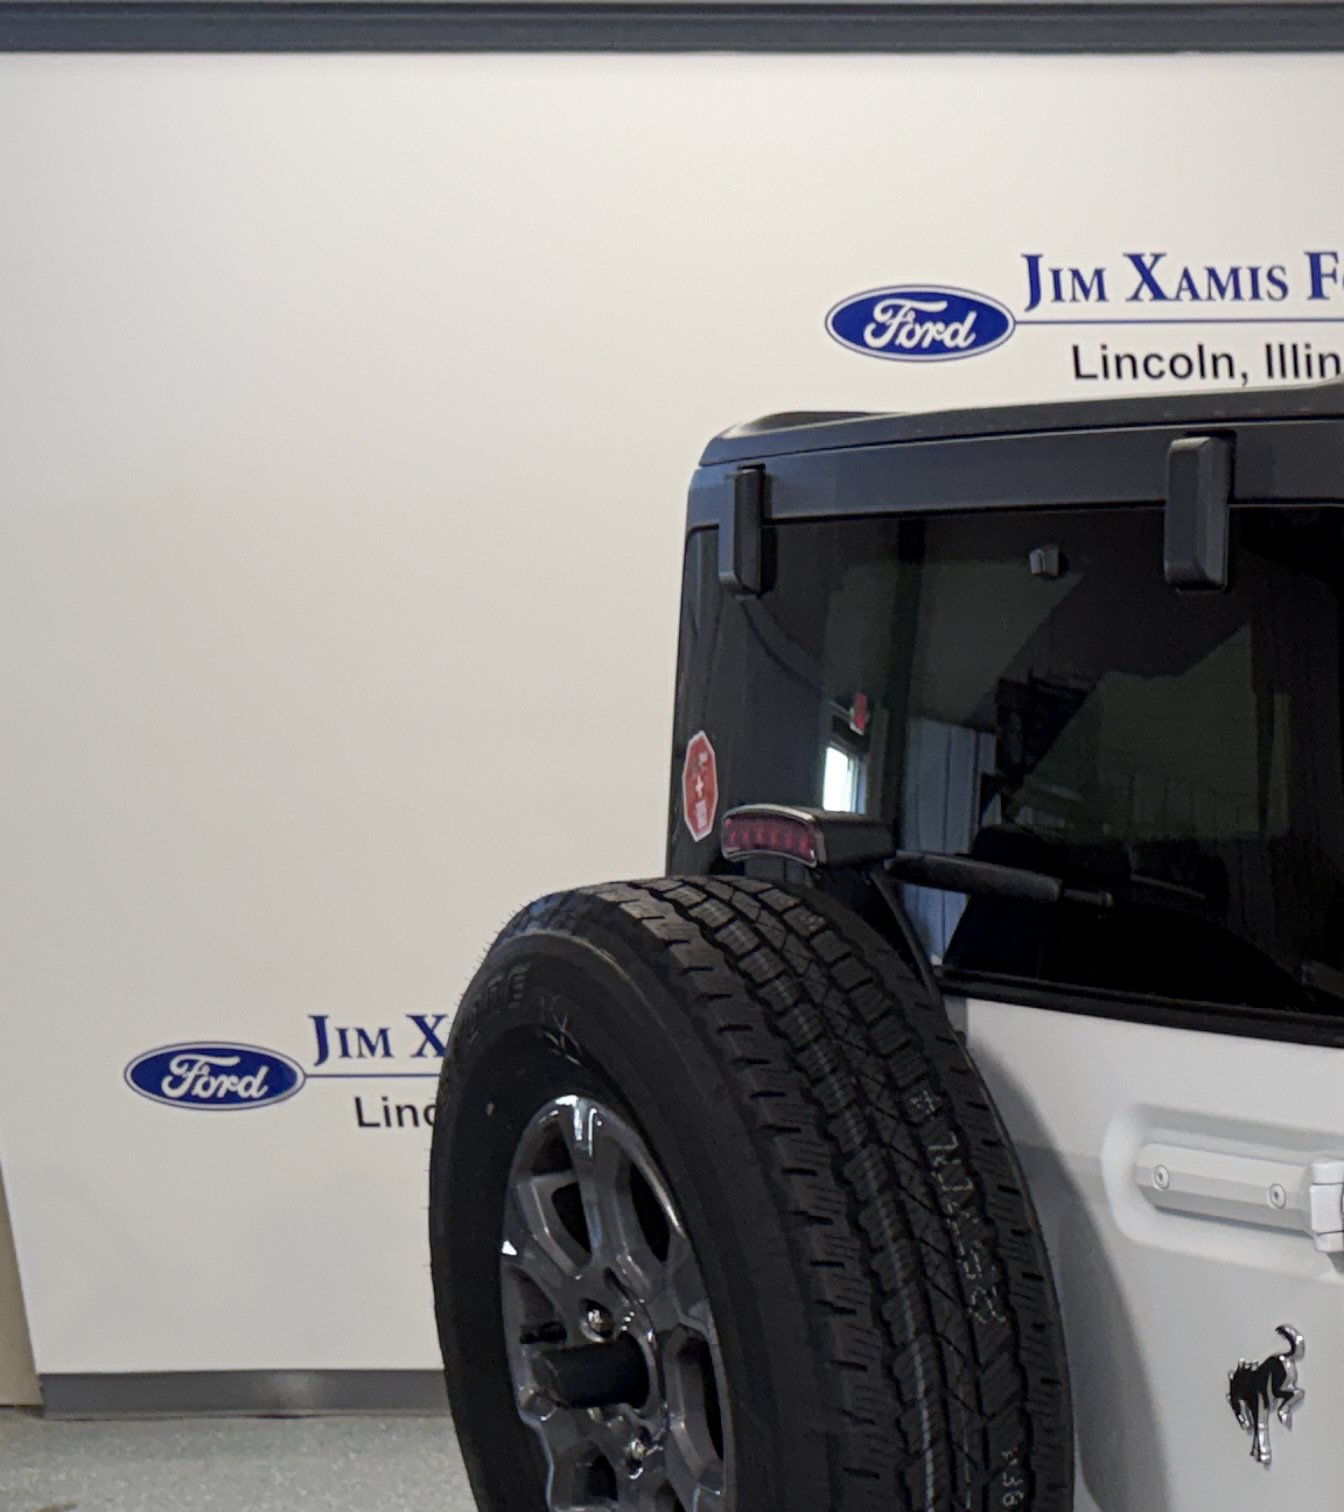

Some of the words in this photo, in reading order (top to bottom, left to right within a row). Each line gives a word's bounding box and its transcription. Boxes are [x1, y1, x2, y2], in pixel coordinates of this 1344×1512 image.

[863, 299, 978, 349] Ford
[1072, 344, 1250, 387] Lincoln,
[161, 1053, 270, 1099] Ford
